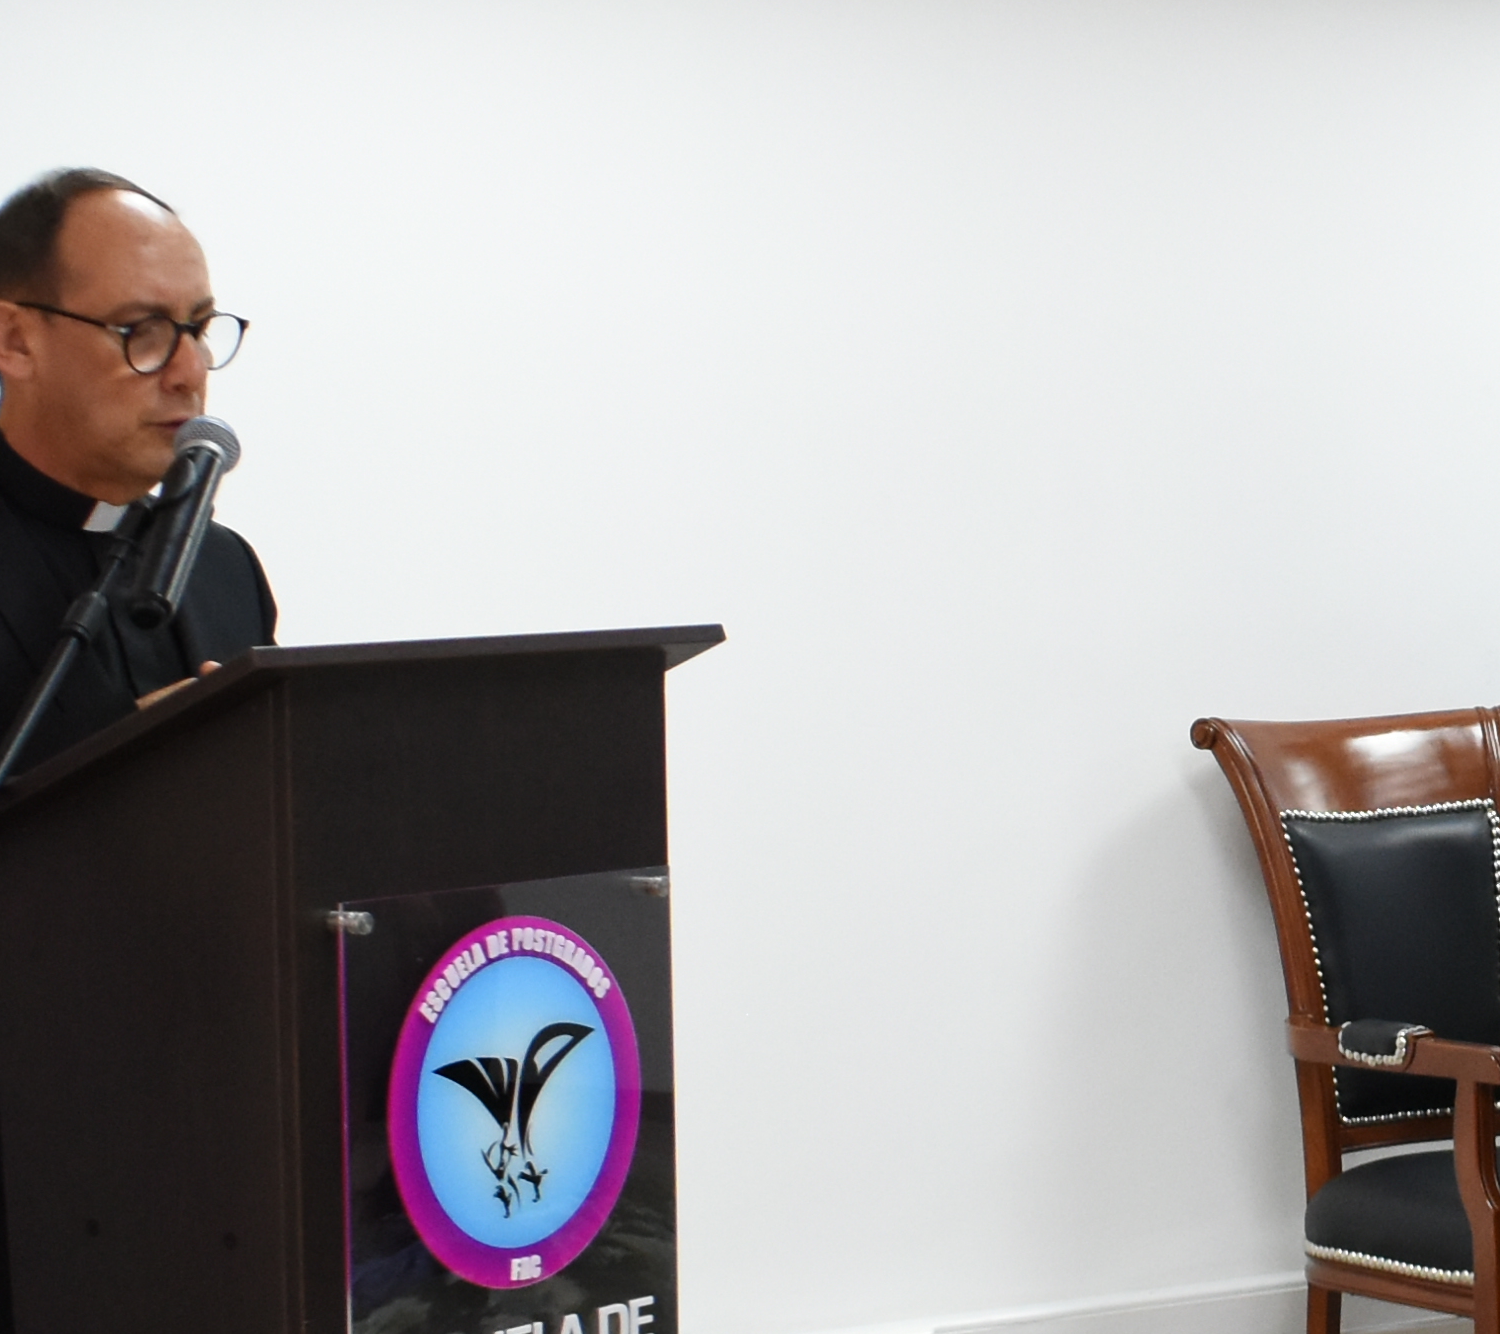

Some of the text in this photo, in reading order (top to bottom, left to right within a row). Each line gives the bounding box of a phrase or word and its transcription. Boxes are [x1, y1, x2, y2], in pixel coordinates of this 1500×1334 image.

[419, 926, 611, 1024] ESCUELA DE POSTGRADOS
